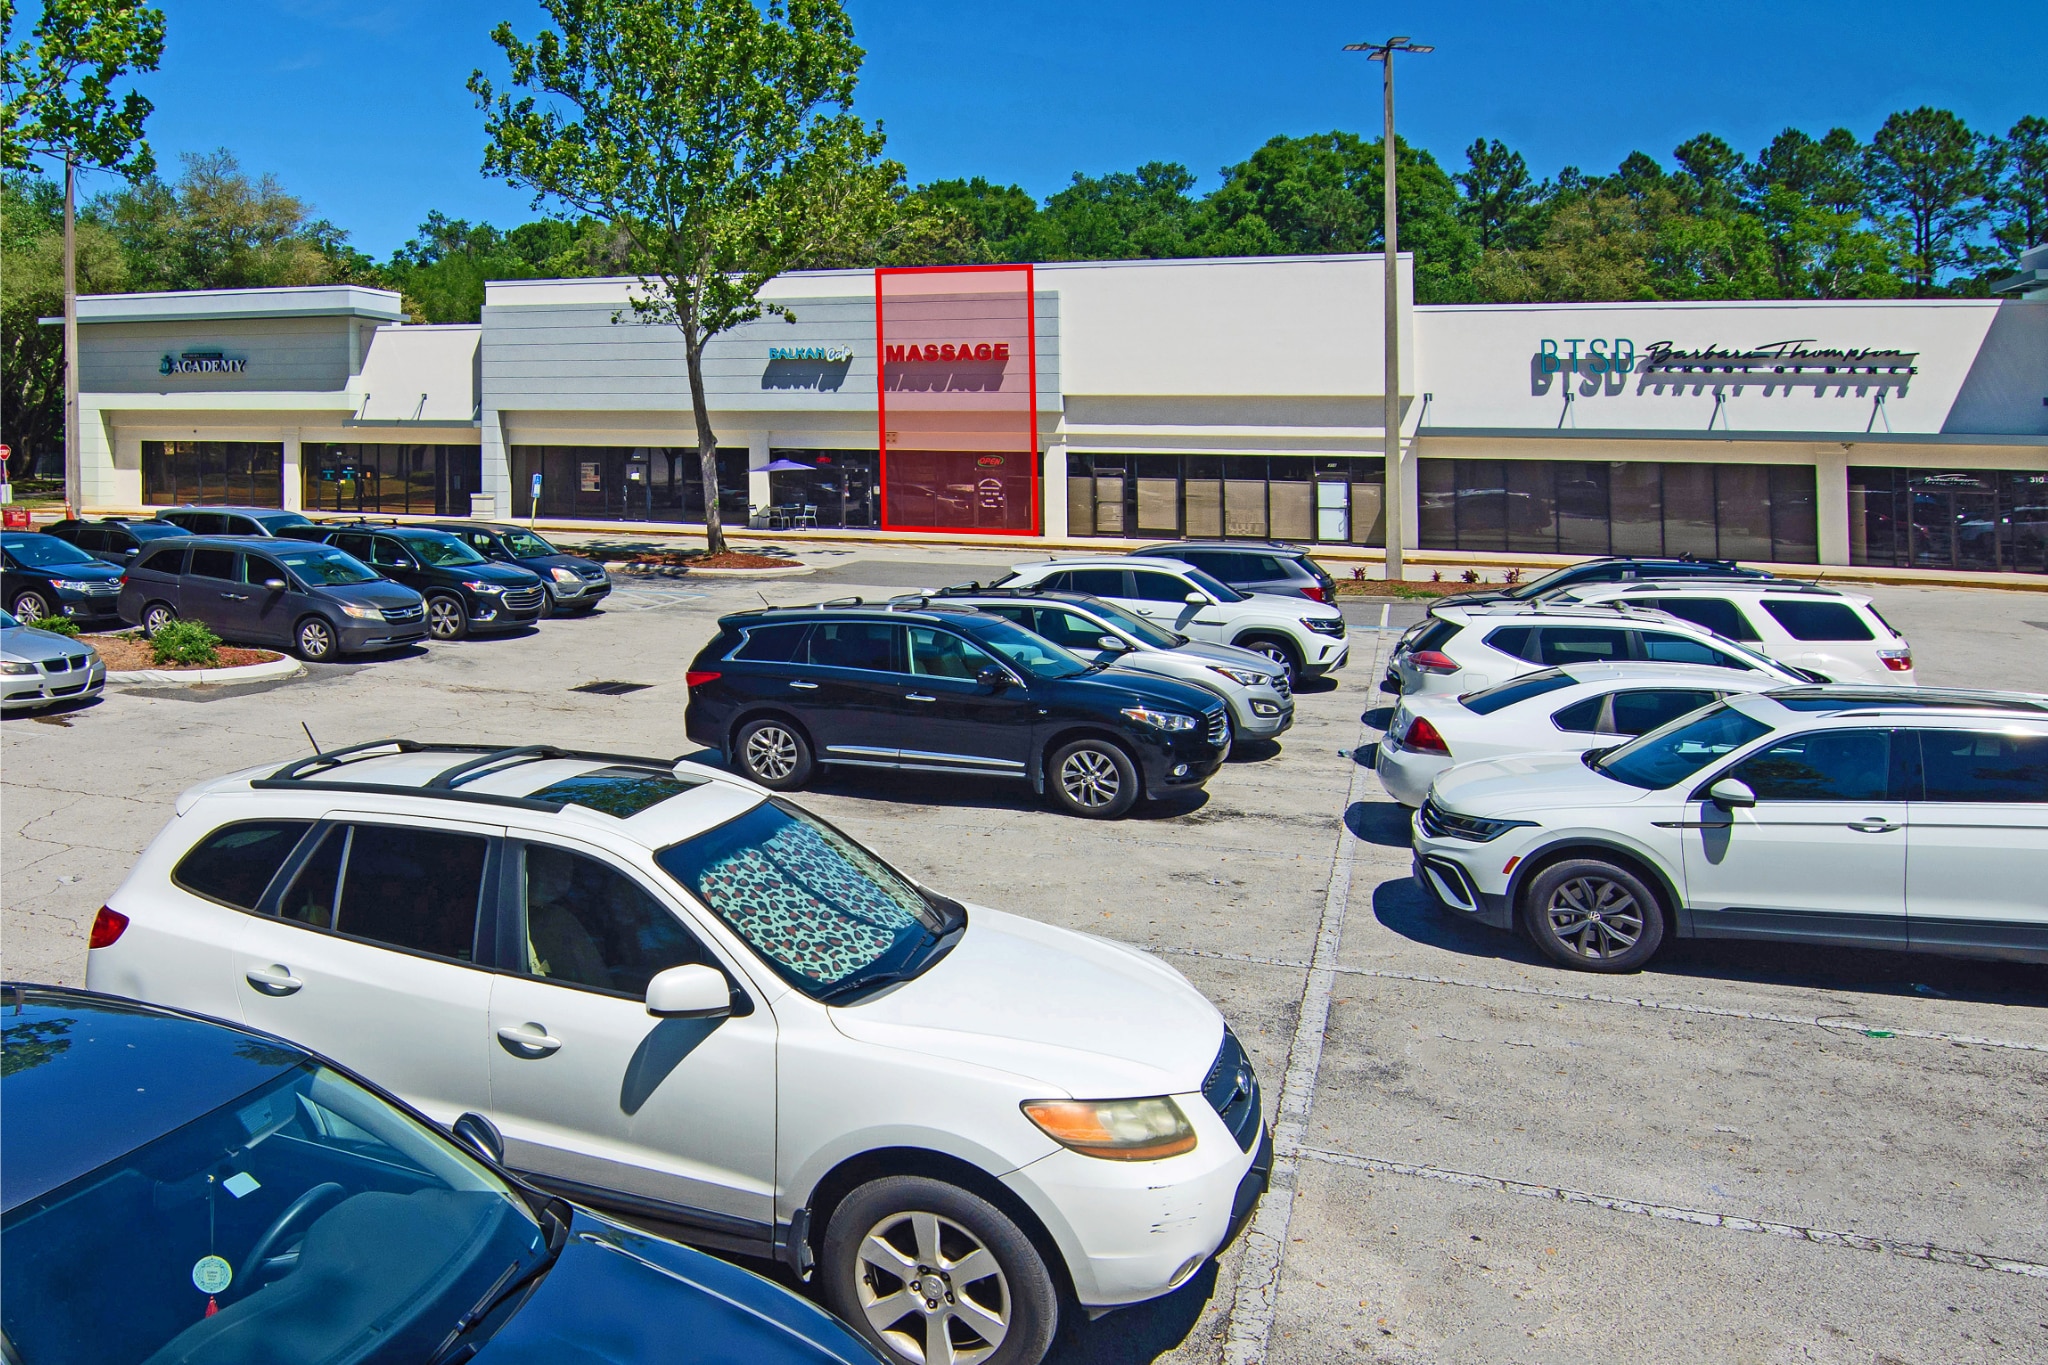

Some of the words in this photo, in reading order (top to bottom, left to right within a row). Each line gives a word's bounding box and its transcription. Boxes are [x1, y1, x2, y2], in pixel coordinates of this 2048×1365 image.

[769, 347, 825, 360] BALKAN
[885, 343, 1010, 362] MASSAGE
[1540, 338, 1635, 374] BTSD
[1645, 341, 1770, 364] Barbara
[1755, 339, 1920, 361] Thompson
[173, 359, 246, 373] ACADEMY
[1647, 365, 1752, 374] SCHOOL
[1774, 365, 1802, 374] OF
[1825, 366, 1918, 375] DANCE
[979, 457, 1001, 465] OPEN
